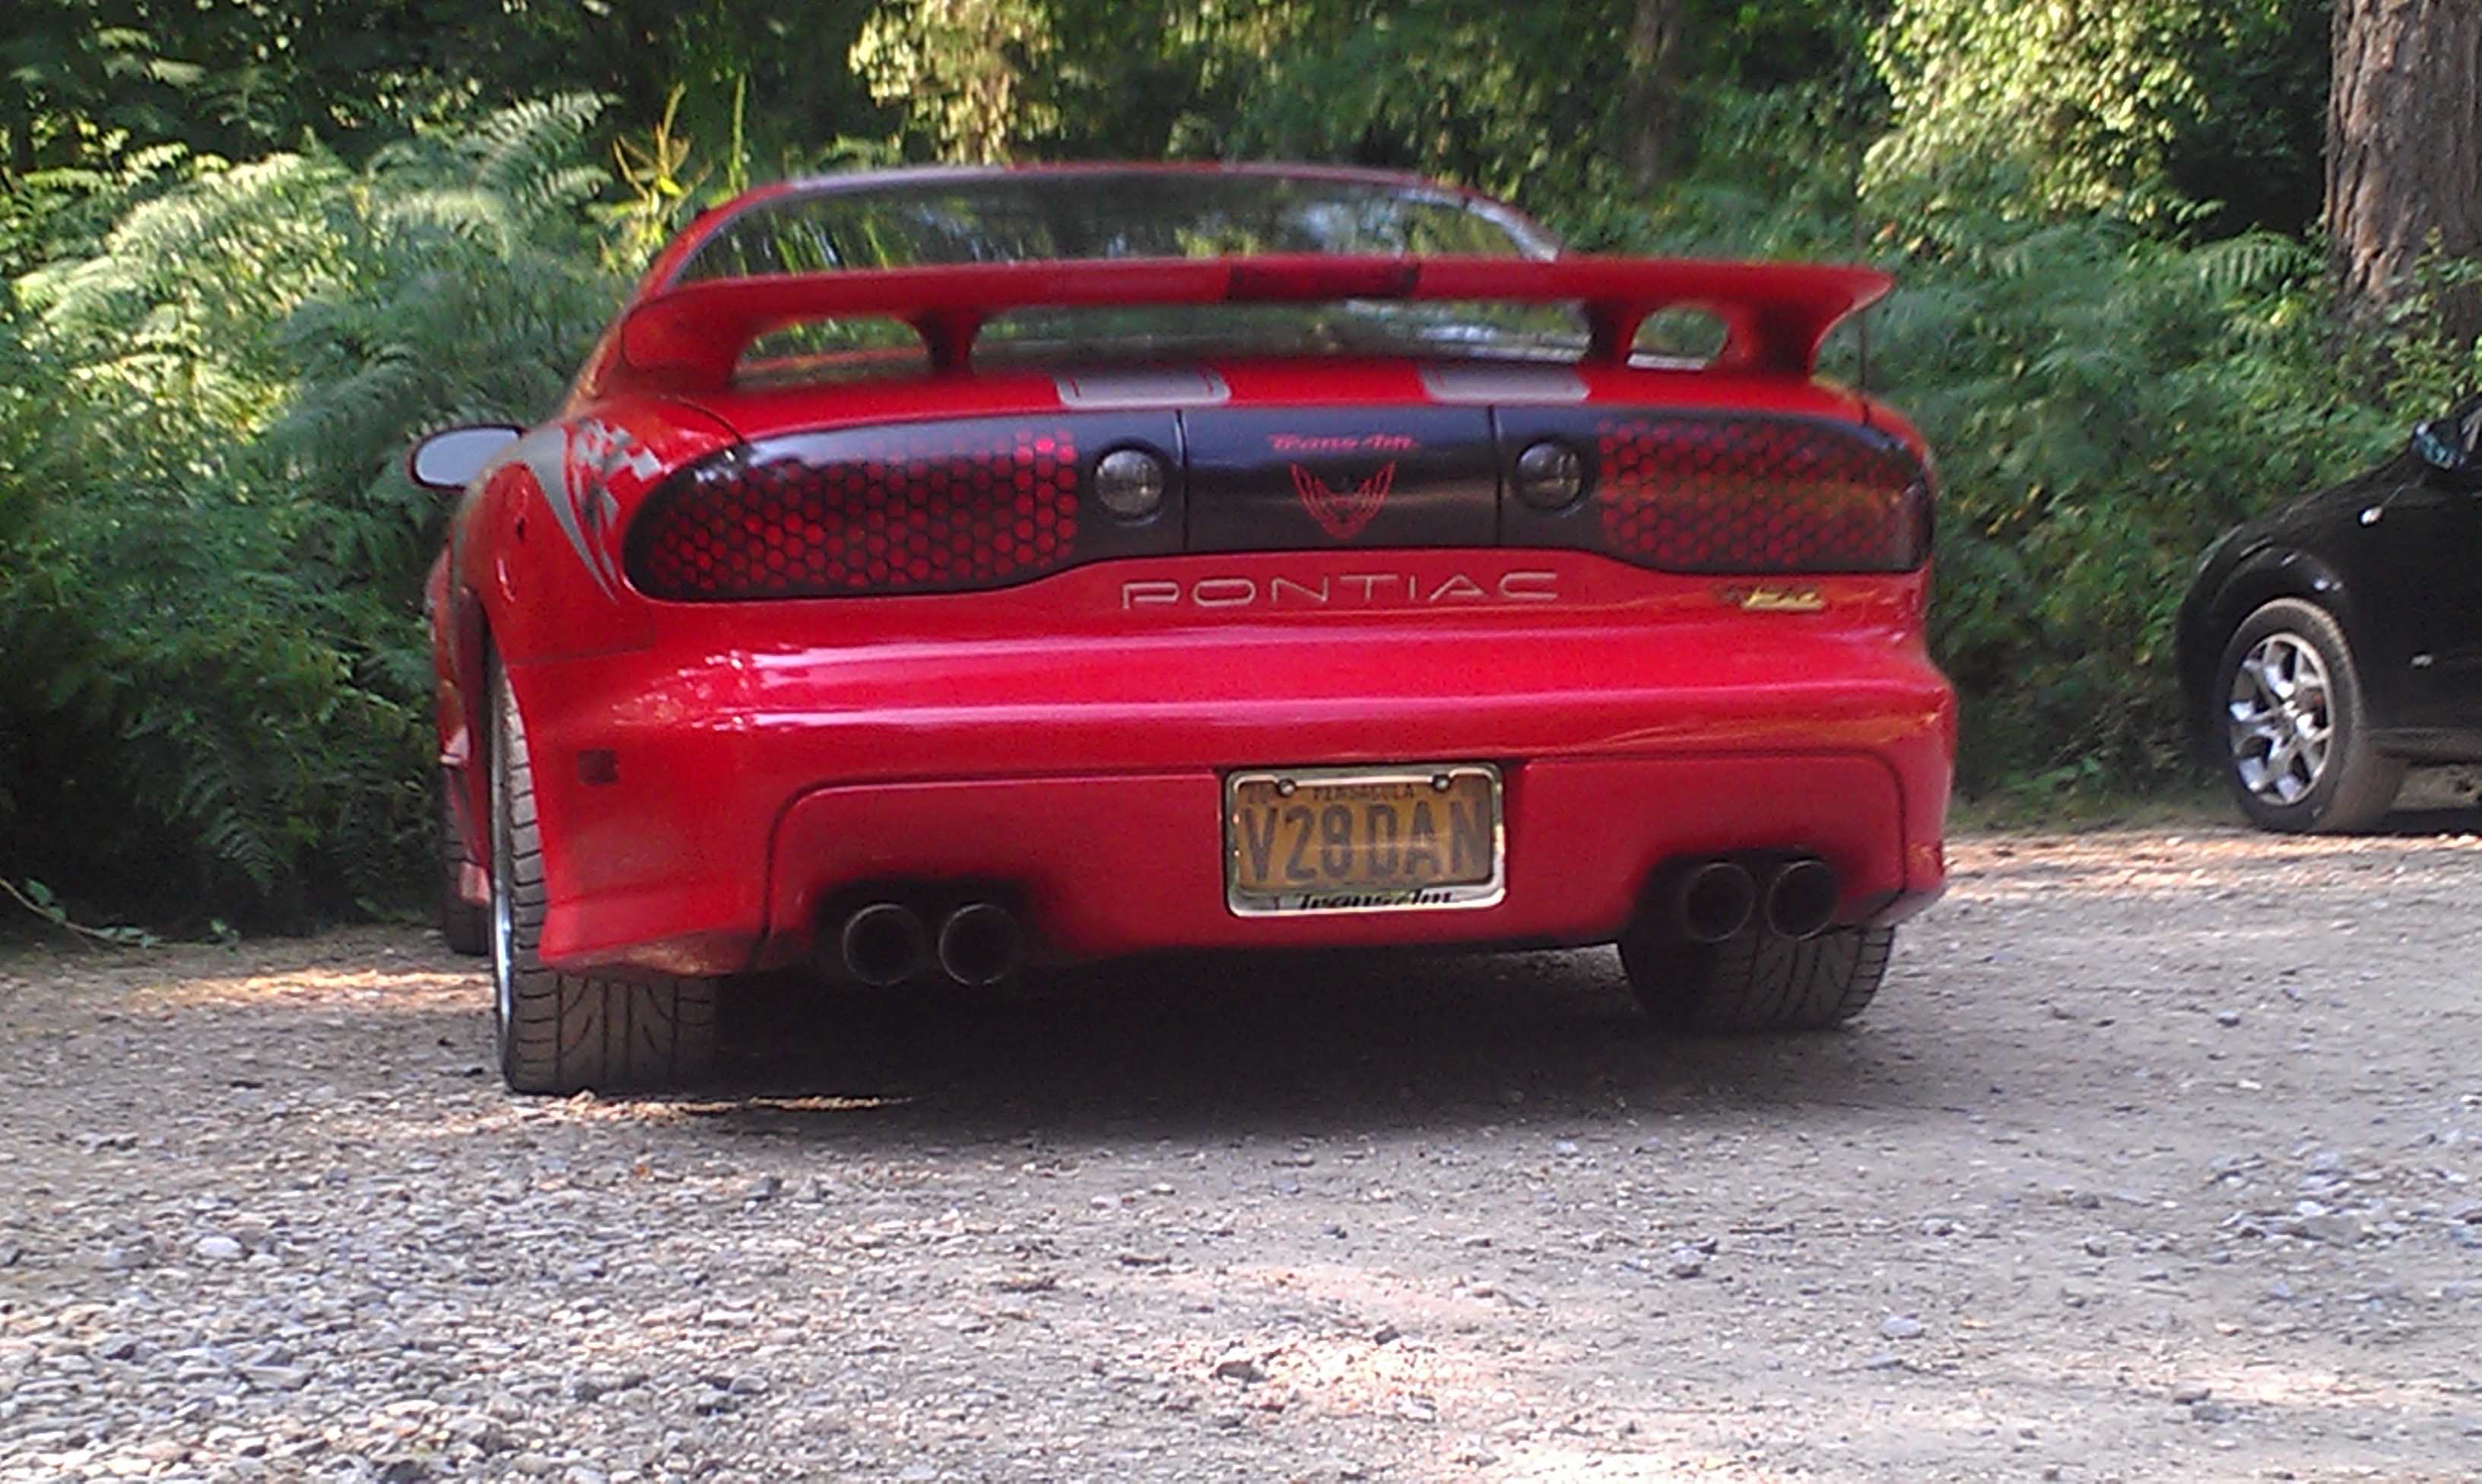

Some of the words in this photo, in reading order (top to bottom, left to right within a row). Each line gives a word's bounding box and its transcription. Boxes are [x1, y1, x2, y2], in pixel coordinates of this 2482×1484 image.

[1122, 571, 1558, 609] PONTIAC
[1244, 804, 1353, 883] V28
[1366, 800, 1484, 876] DAN
